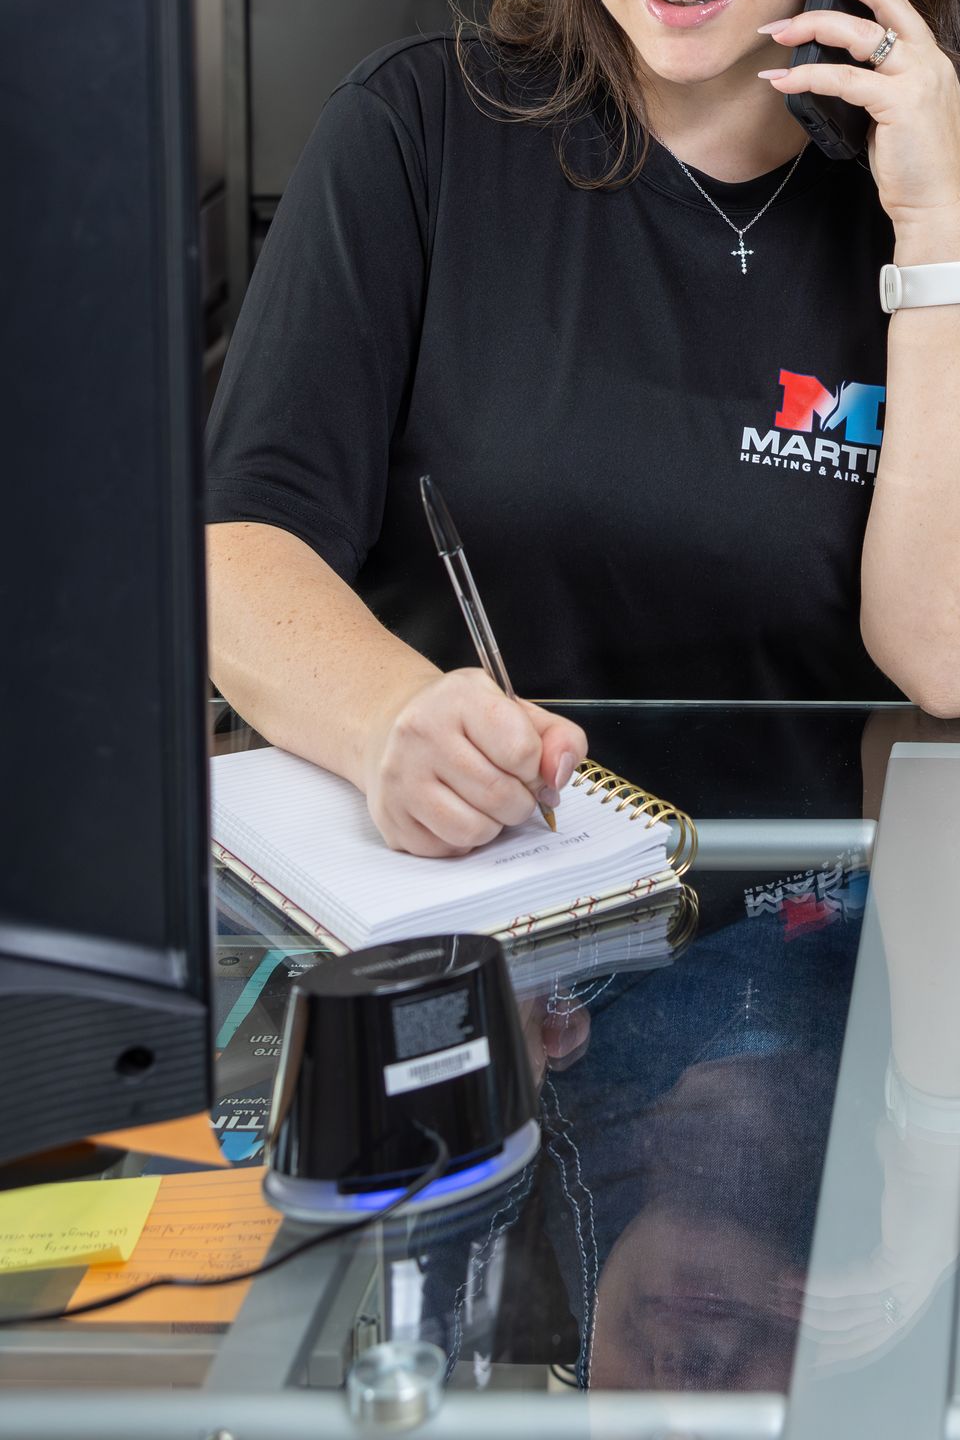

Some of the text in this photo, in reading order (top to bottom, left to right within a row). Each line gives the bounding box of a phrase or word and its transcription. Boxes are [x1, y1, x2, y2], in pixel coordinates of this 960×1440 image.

[740, 426, 878, 474] MARTI
[740, 452, 812, 473] HEATING
[817, 466, 827, 476] &
[833, 470, 866, 486] AIR,
[254, 1048, 282, 1056] are
